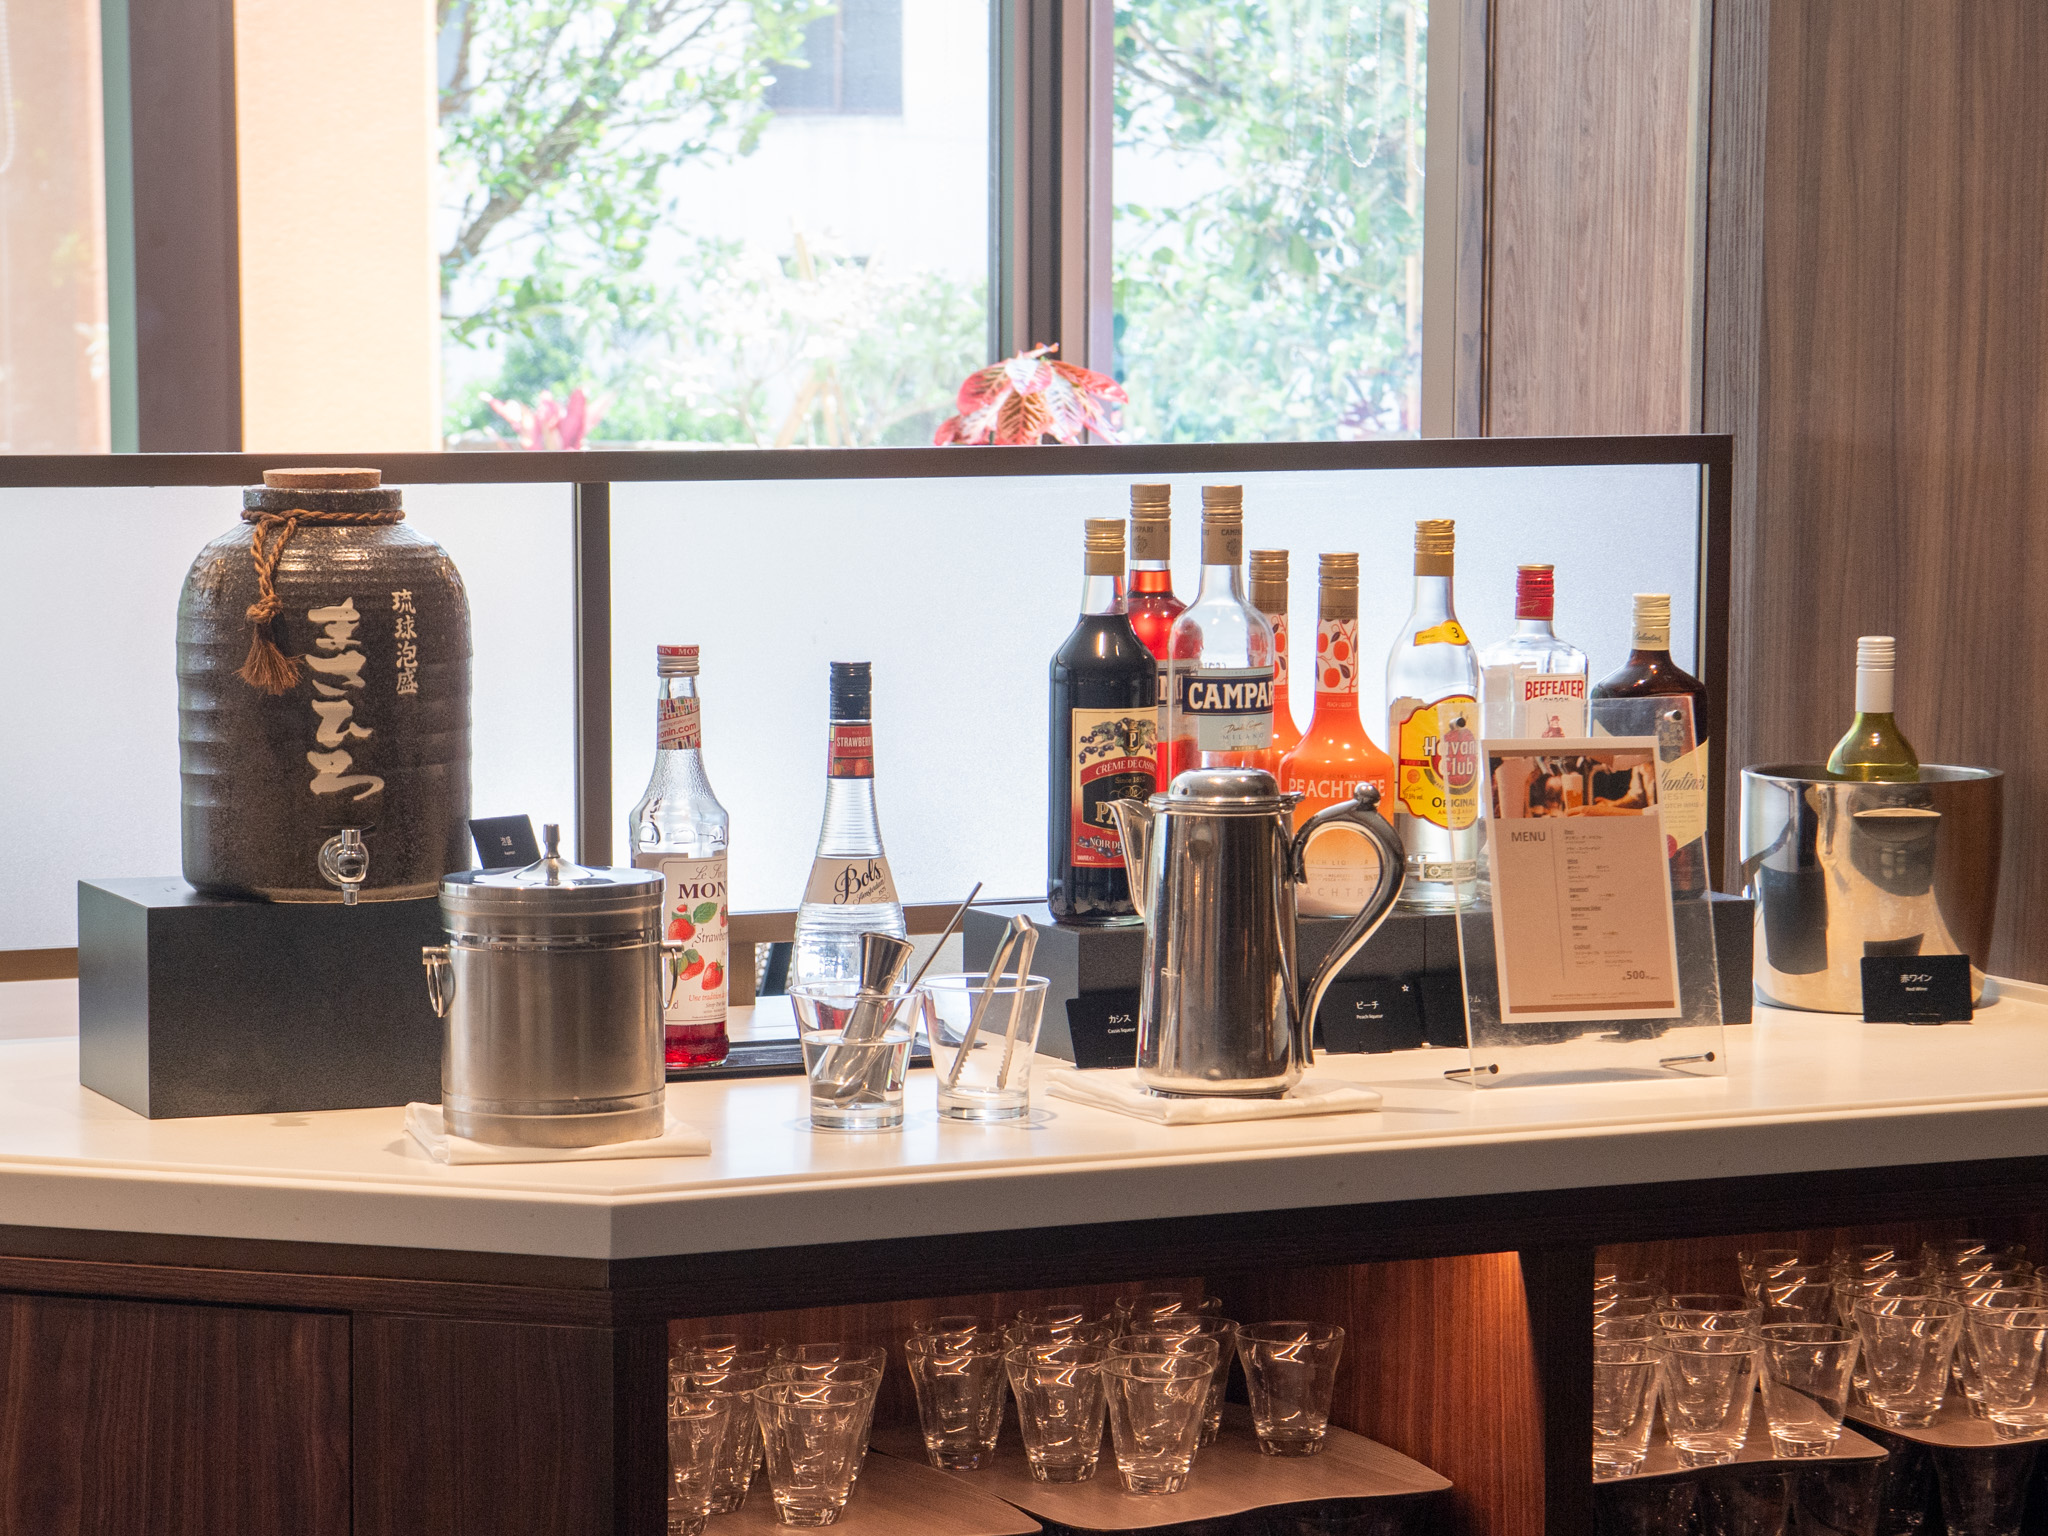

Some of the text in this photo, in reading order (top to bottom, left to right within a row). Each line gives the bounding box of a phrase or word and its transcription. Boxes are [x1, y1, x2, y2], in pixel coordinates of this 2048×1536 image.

[1452, 627, 1460, 638] 3
[391, 588, 418, 694] 琉球泡盛
[1525, 680, 1585, 701] BEEFEATER
[307, 597, 384, 800] まさひろ
[1127, 760, 1138, 769] DE
[1511, 831, 1546, 842] MENU
[1090, 837, 1110, 849] NOIR
[834, 859, 884, 904] Bols
[1626, 970, 1645, 979] 500
[1900, 974, 1933, 984] 赤ワイン
[1356, 1000, 1379, 1010] ピーチ
[1108, 1014, 1131, 1024] カシス
